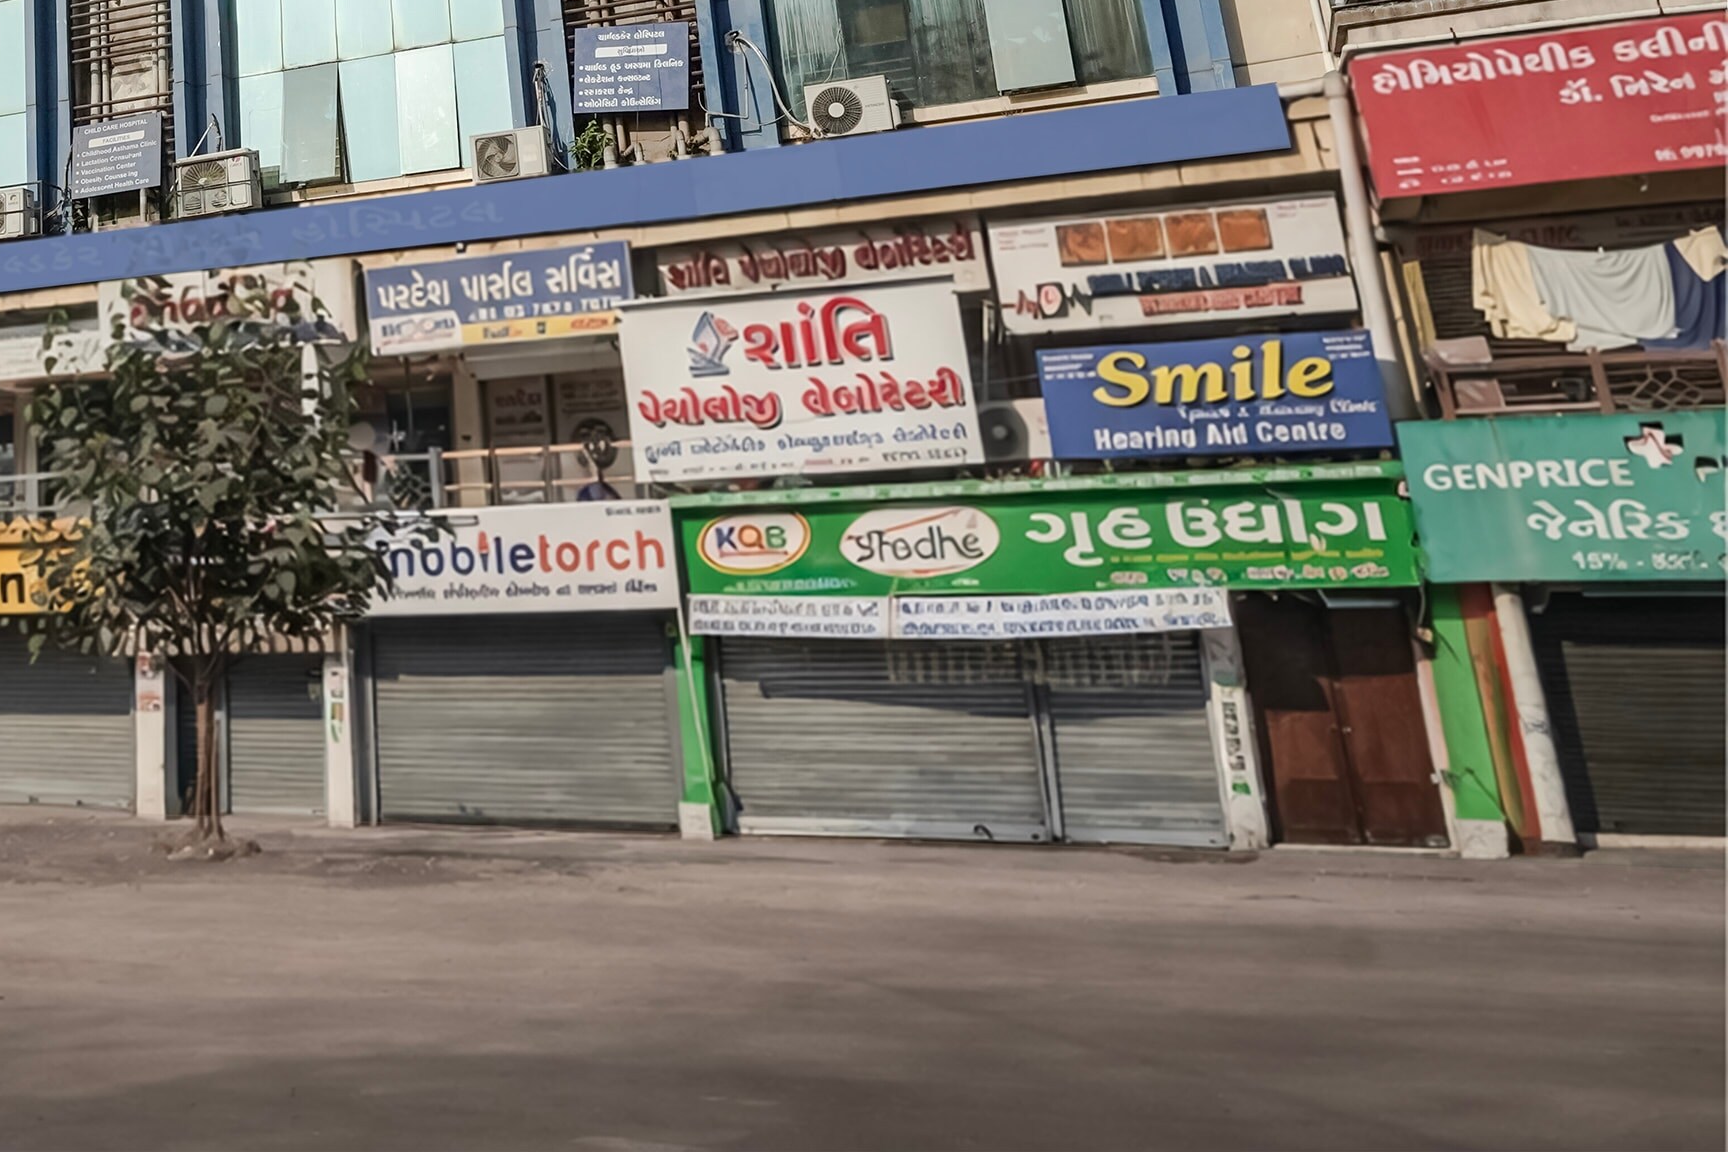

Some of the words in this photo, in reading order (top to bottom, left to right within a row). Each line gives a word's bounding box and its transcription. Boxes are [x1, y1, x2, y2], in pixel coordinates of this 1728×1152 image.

[84, 127, 102, 135] CHILD
[102, 124, 118, 132] CARE
[119, 119, 148, 128] HOSPITAL
[81, 148, 112, 158] Childhood
[139, 140, 157, 148] Clinic
[80, 165, 115, 175] Vaccination
[116, 161, 136, 170] Center
[81, 157, 108, 167] Lactation
[80, 176, 102, 185] Obesity
[104, 170, 138, 181] Counseing
[80, 184, 113, 194] Adolescent
[114, 180, 134, 189] Health
[134, 177, 149, 185] Care
[376, 270, 451, 310] પરદેશ
[460, 261, 534, 302] પાર્સલ
[545, 247, 621, 294] સર્વિસ
[742, 296, 894, 370] શાંતિ
[1092, 339, 1335, 407] Smile
[1093, 425, 1196, 451] Hearing
[1206, 422, 1249, 446] Aid
[1255, 420, 1347, 444] Centre
[1423, 458, 1635, 491] GENPRICE
